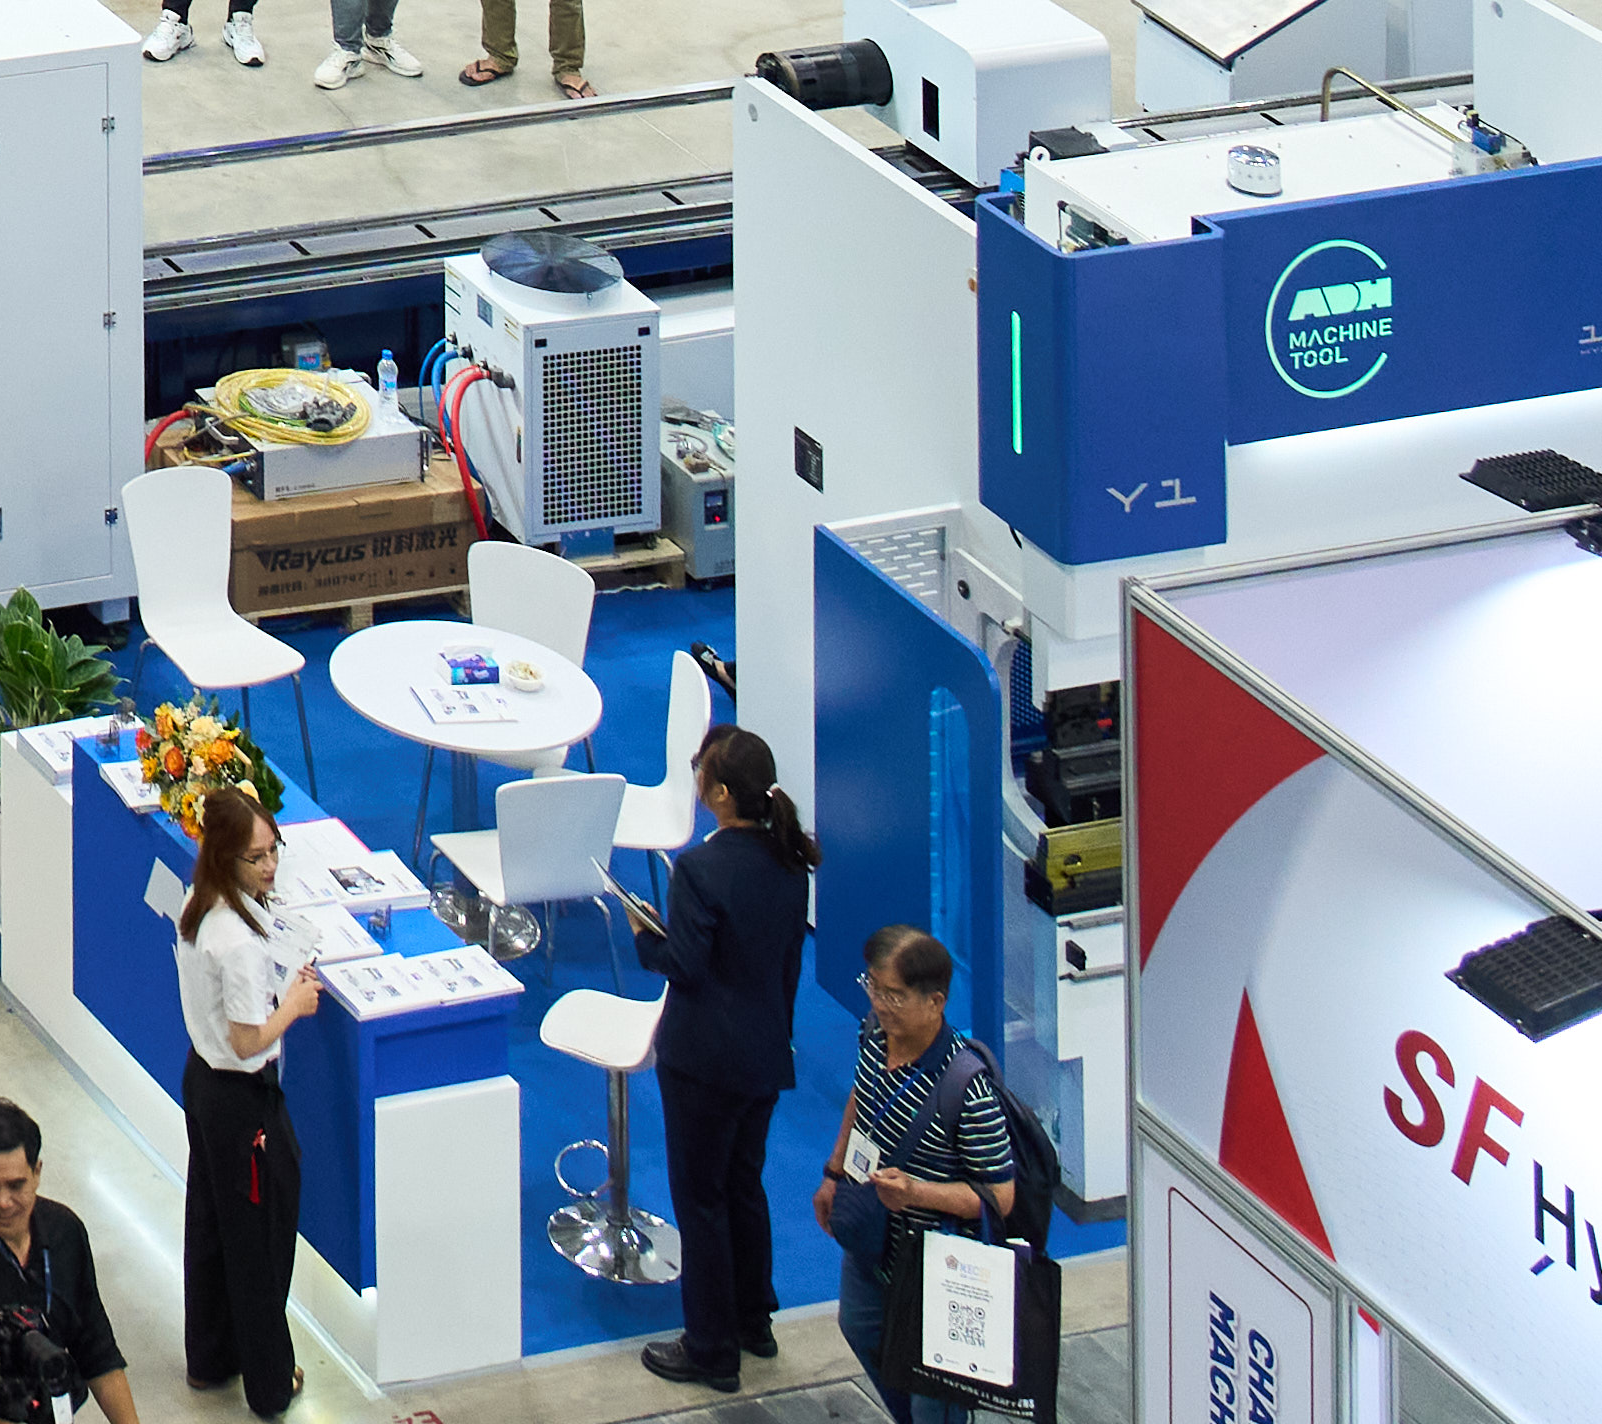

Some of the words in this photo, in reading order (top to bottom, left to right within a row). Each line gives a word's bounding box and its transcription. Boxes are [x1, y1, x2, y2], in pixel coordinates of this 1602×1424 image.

[1287, 275, 1394, 322] ADH
[1289, 317, 1394, 351] MACHINE
[1289, 346, 1350, 370] TOOL
[1105, 477, 1198, 514] Y1
[269, 546, 366, 575] Raycus
[1383, 1028, 1525, 1186] SF
